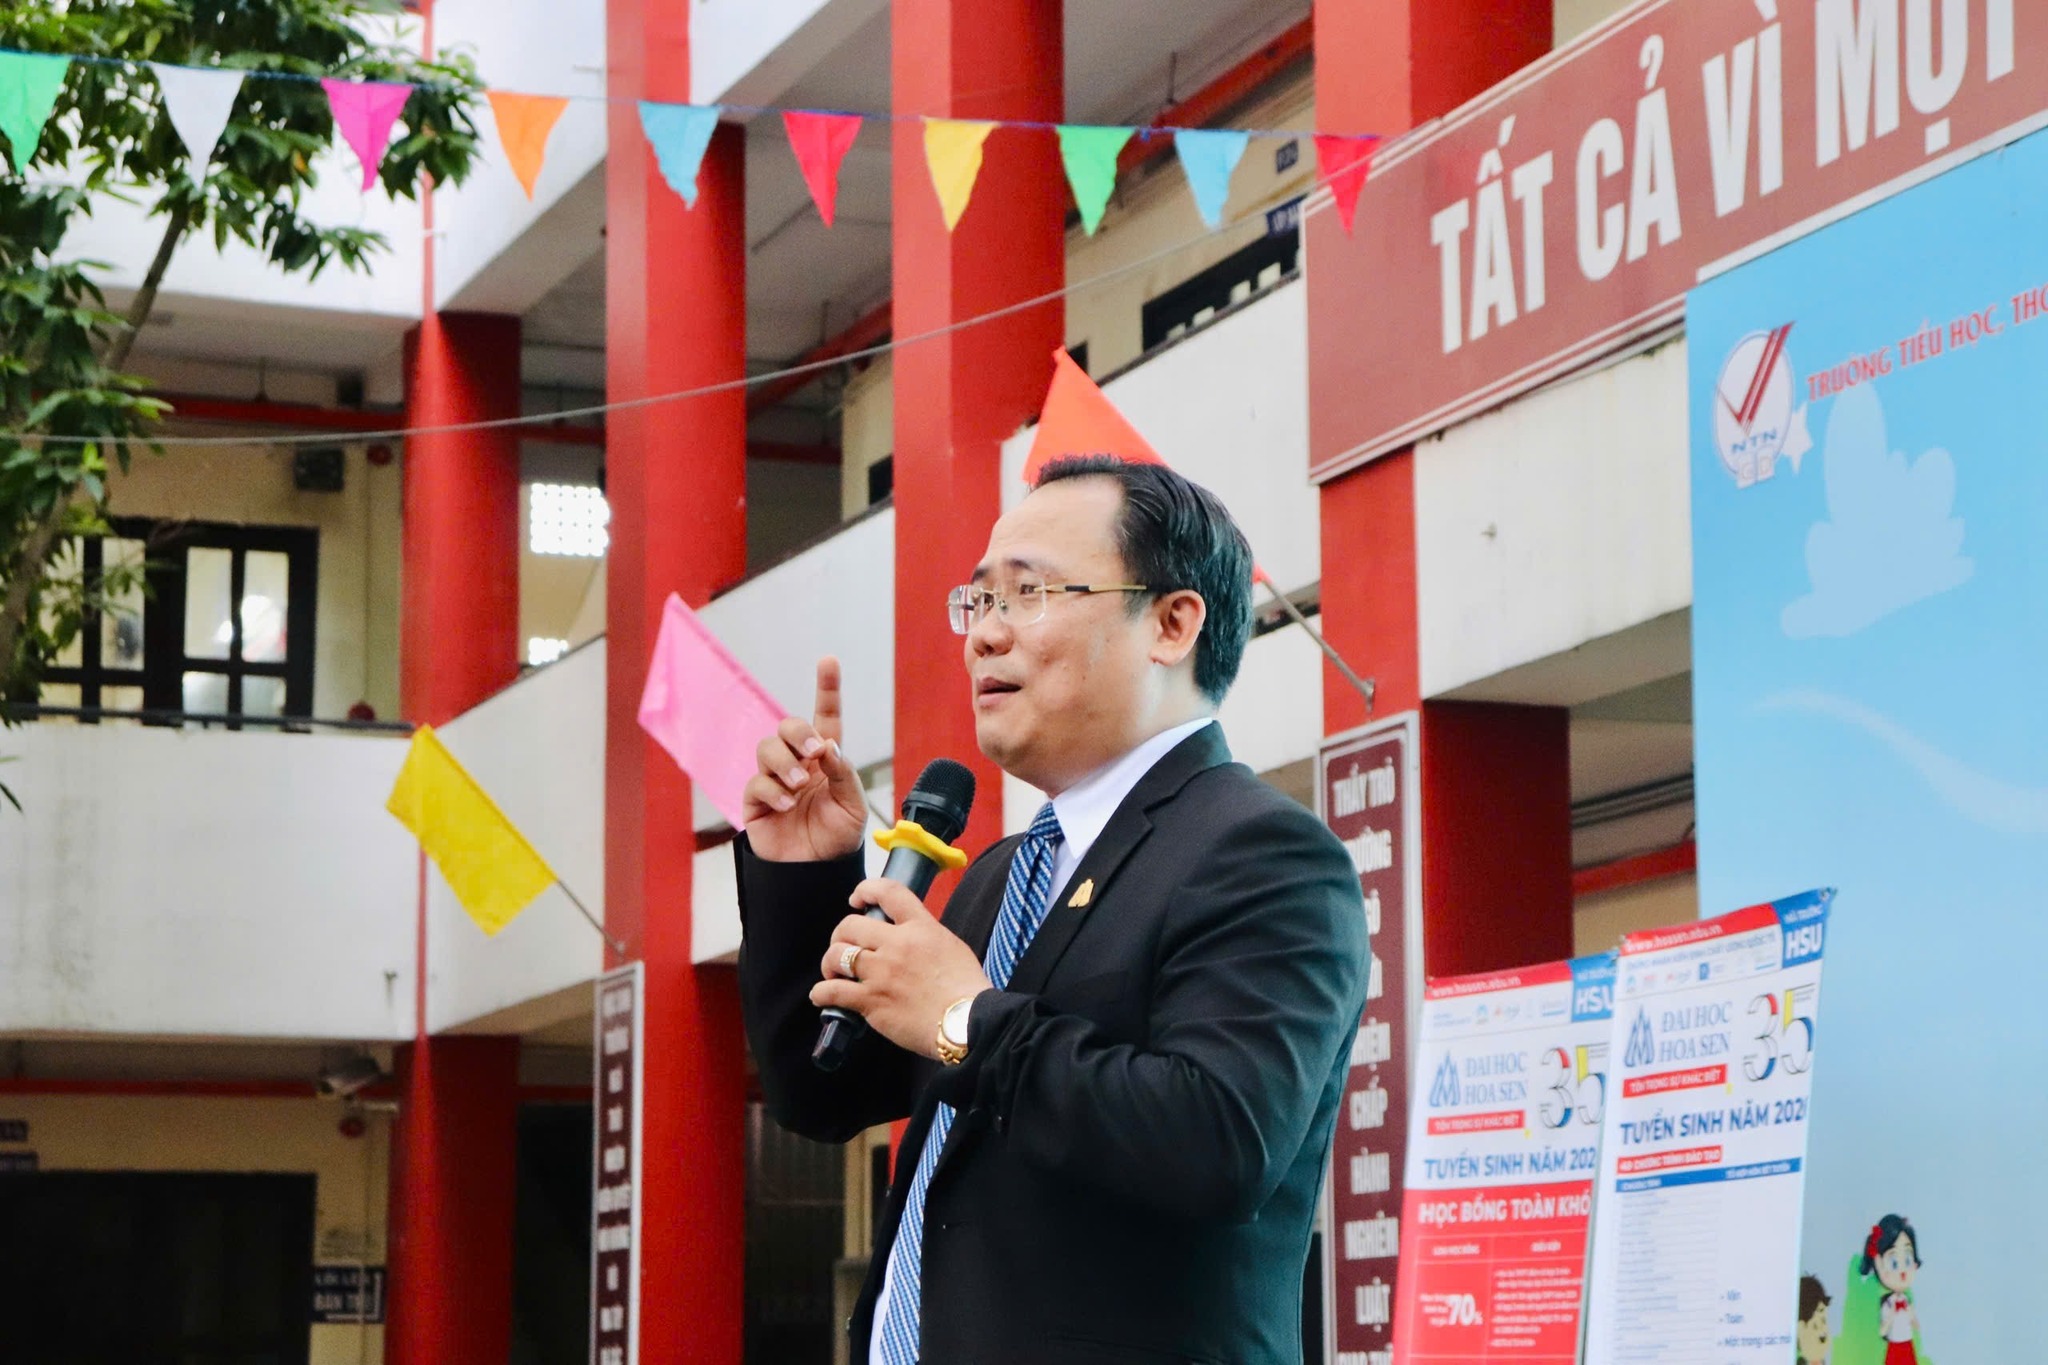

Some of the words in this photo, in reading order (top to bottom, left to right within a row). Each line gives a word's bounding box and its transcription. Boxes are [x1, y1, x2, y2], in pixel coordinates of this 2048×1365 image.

[1430, 114, 1553, 355] TẤT
[1576, 34, 1683, 281] CẢ
[1702, 0, 1784, 218] VÌ
[1731, 428, 1777, 453] NTN
[1785, 922, 1824, 960] HSU
[1660, 1038, 1696, 1062] HOA
[1699, 1032, 1732, 1056] SEN
[1744, 984, 1815, 1082] 35
[1465, 1083, 1497, 1104] HOA
[1499, 1079, 1529, 1101] SEN
[1680, 1110, 1724, 1137] SINH
[1729, 1099, 1770, 1131] NĂM
[1484, 1153, 1523, 1176] SINH
[1529, 1146, 1566, 1172] NĂM
[1418, 1201, 1458, 1229] HỌC
[1510, 1192, 1555, 1220] TOÀN
